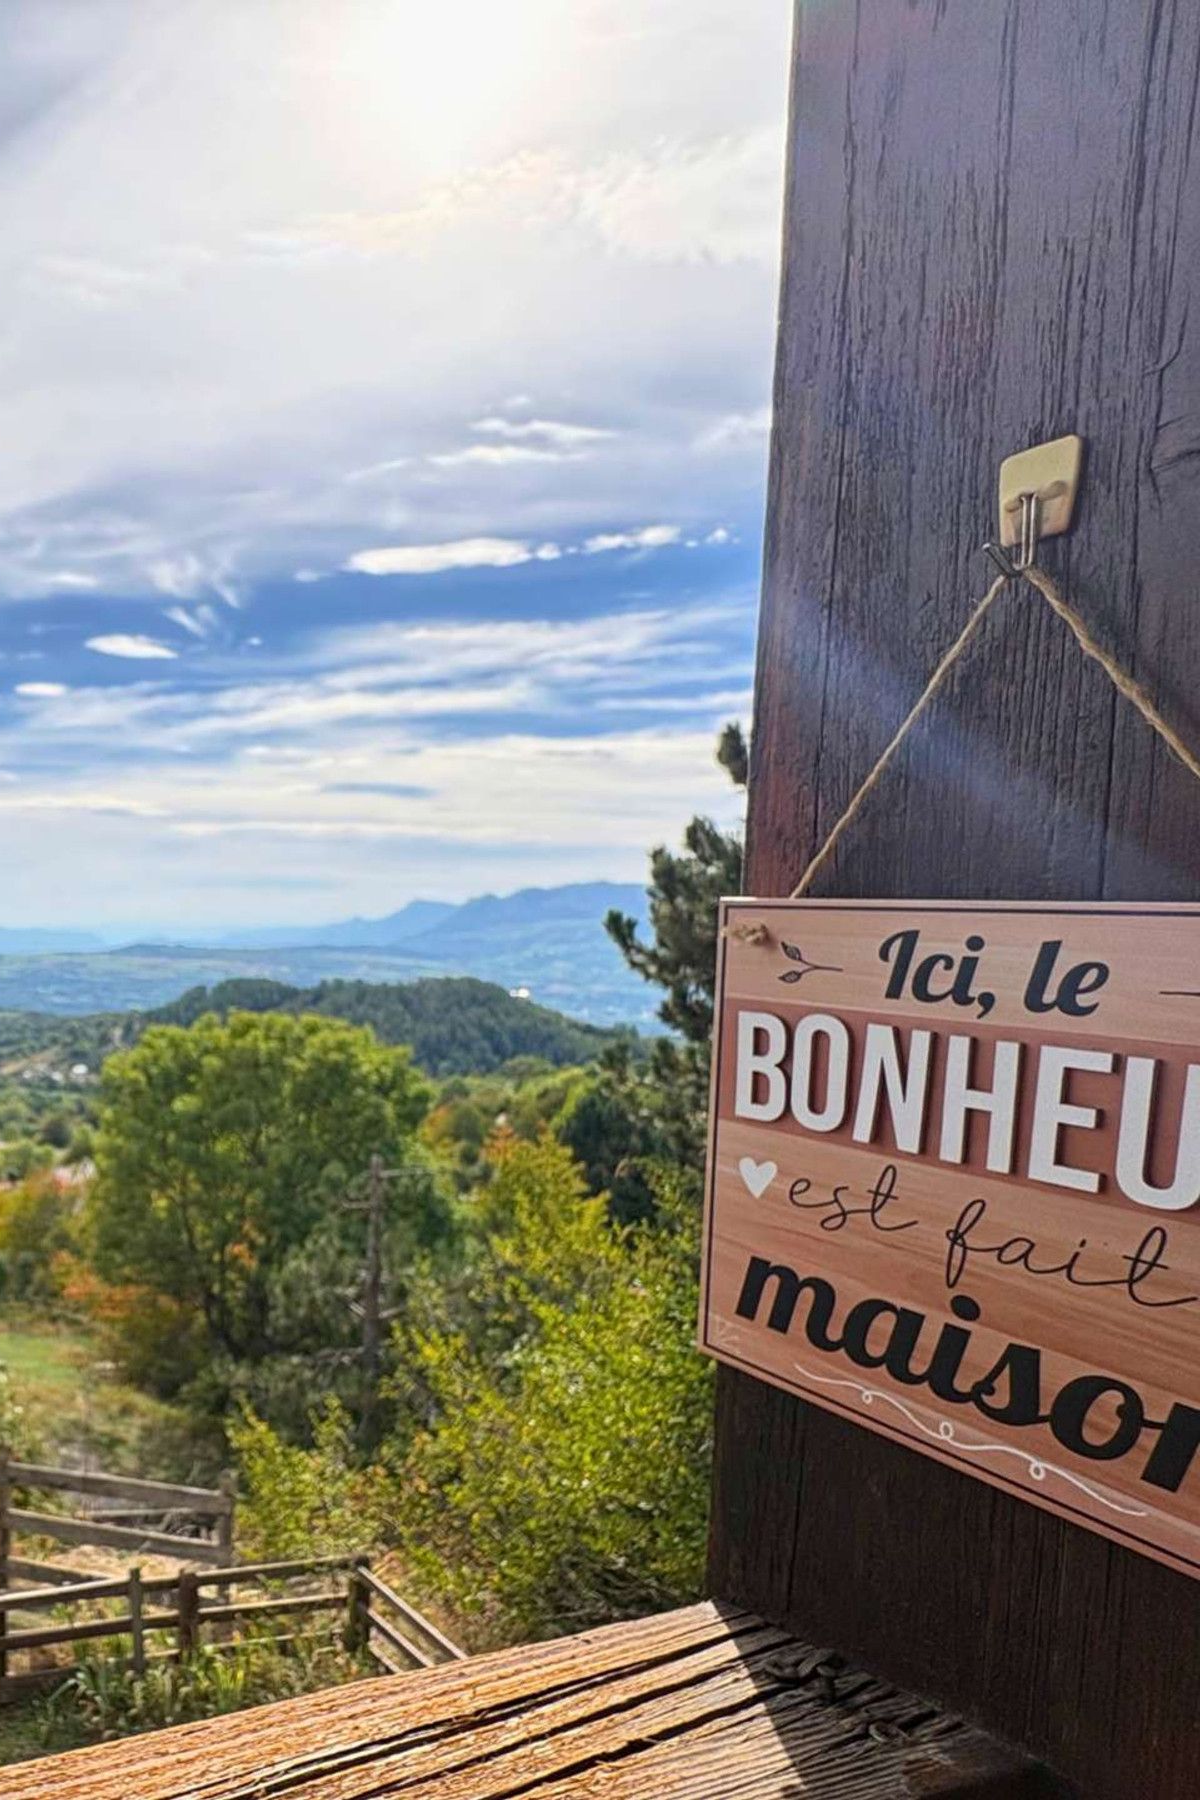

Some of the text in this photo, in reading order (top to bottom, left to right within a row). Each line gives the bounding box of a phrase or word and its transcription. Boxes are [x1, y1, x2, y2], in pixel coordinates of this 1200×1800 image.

[878, 929, 1110, 1019] Ici, le
[788, 1164, 1199, 1307] est fait
